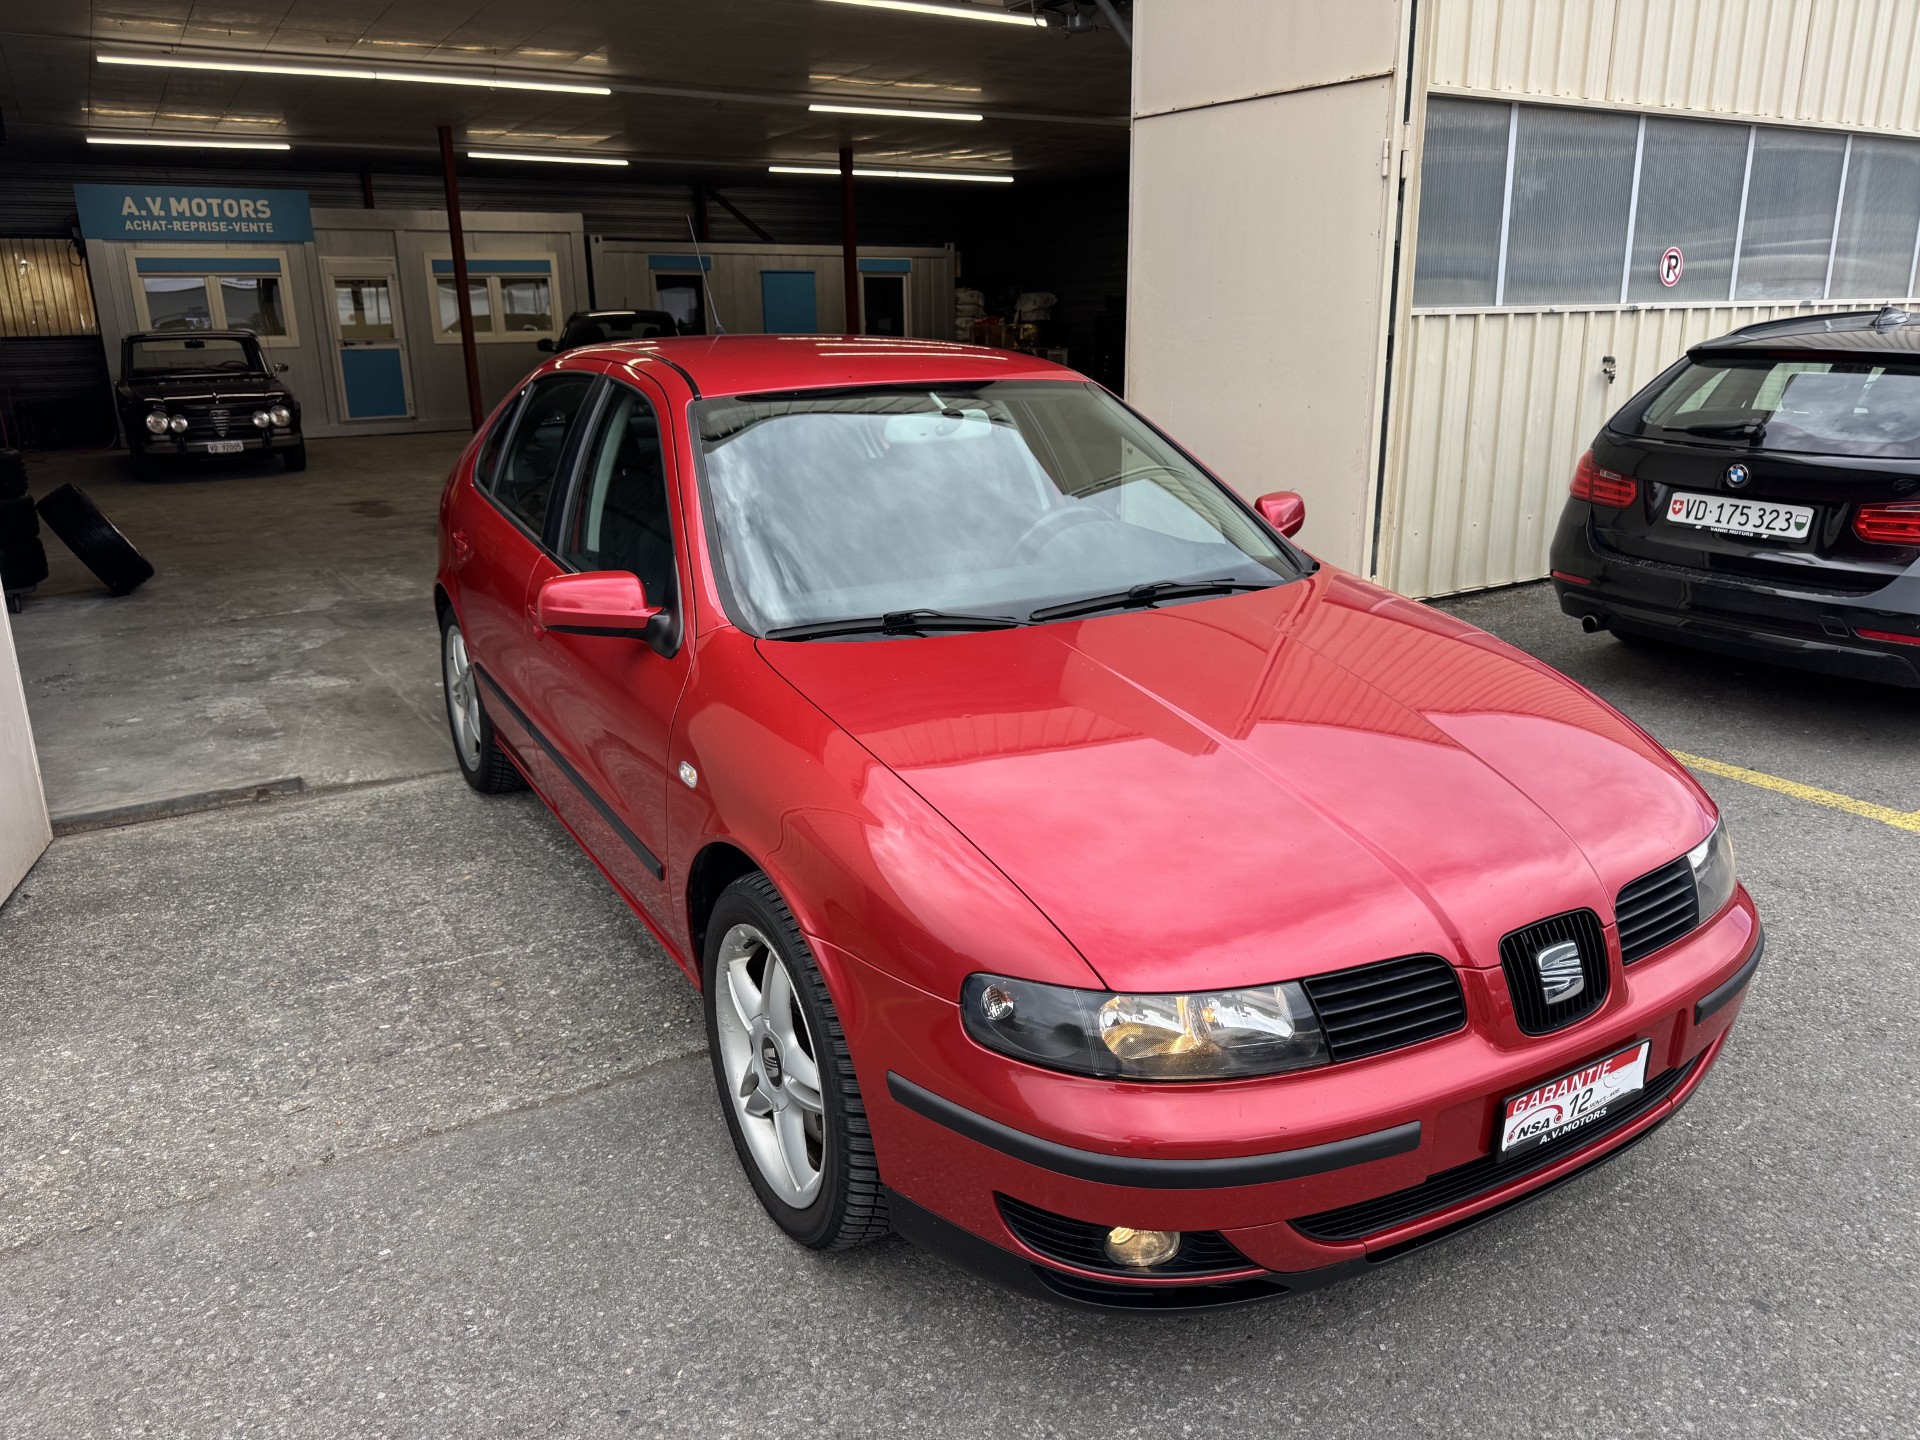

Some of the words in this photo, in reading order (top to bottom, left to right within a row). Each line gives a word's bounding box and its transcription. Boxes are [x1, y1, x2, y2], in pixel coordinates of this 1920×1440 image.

[121, 196, 165, 216] A.V.
[169, 197, 272, 218] MOTORS
[1513, 1058, 1613, 1117] GARANTIE
[1517, 1117, 1550, 1140] NSA
[1569, 1087, 1594, 1118] 12
